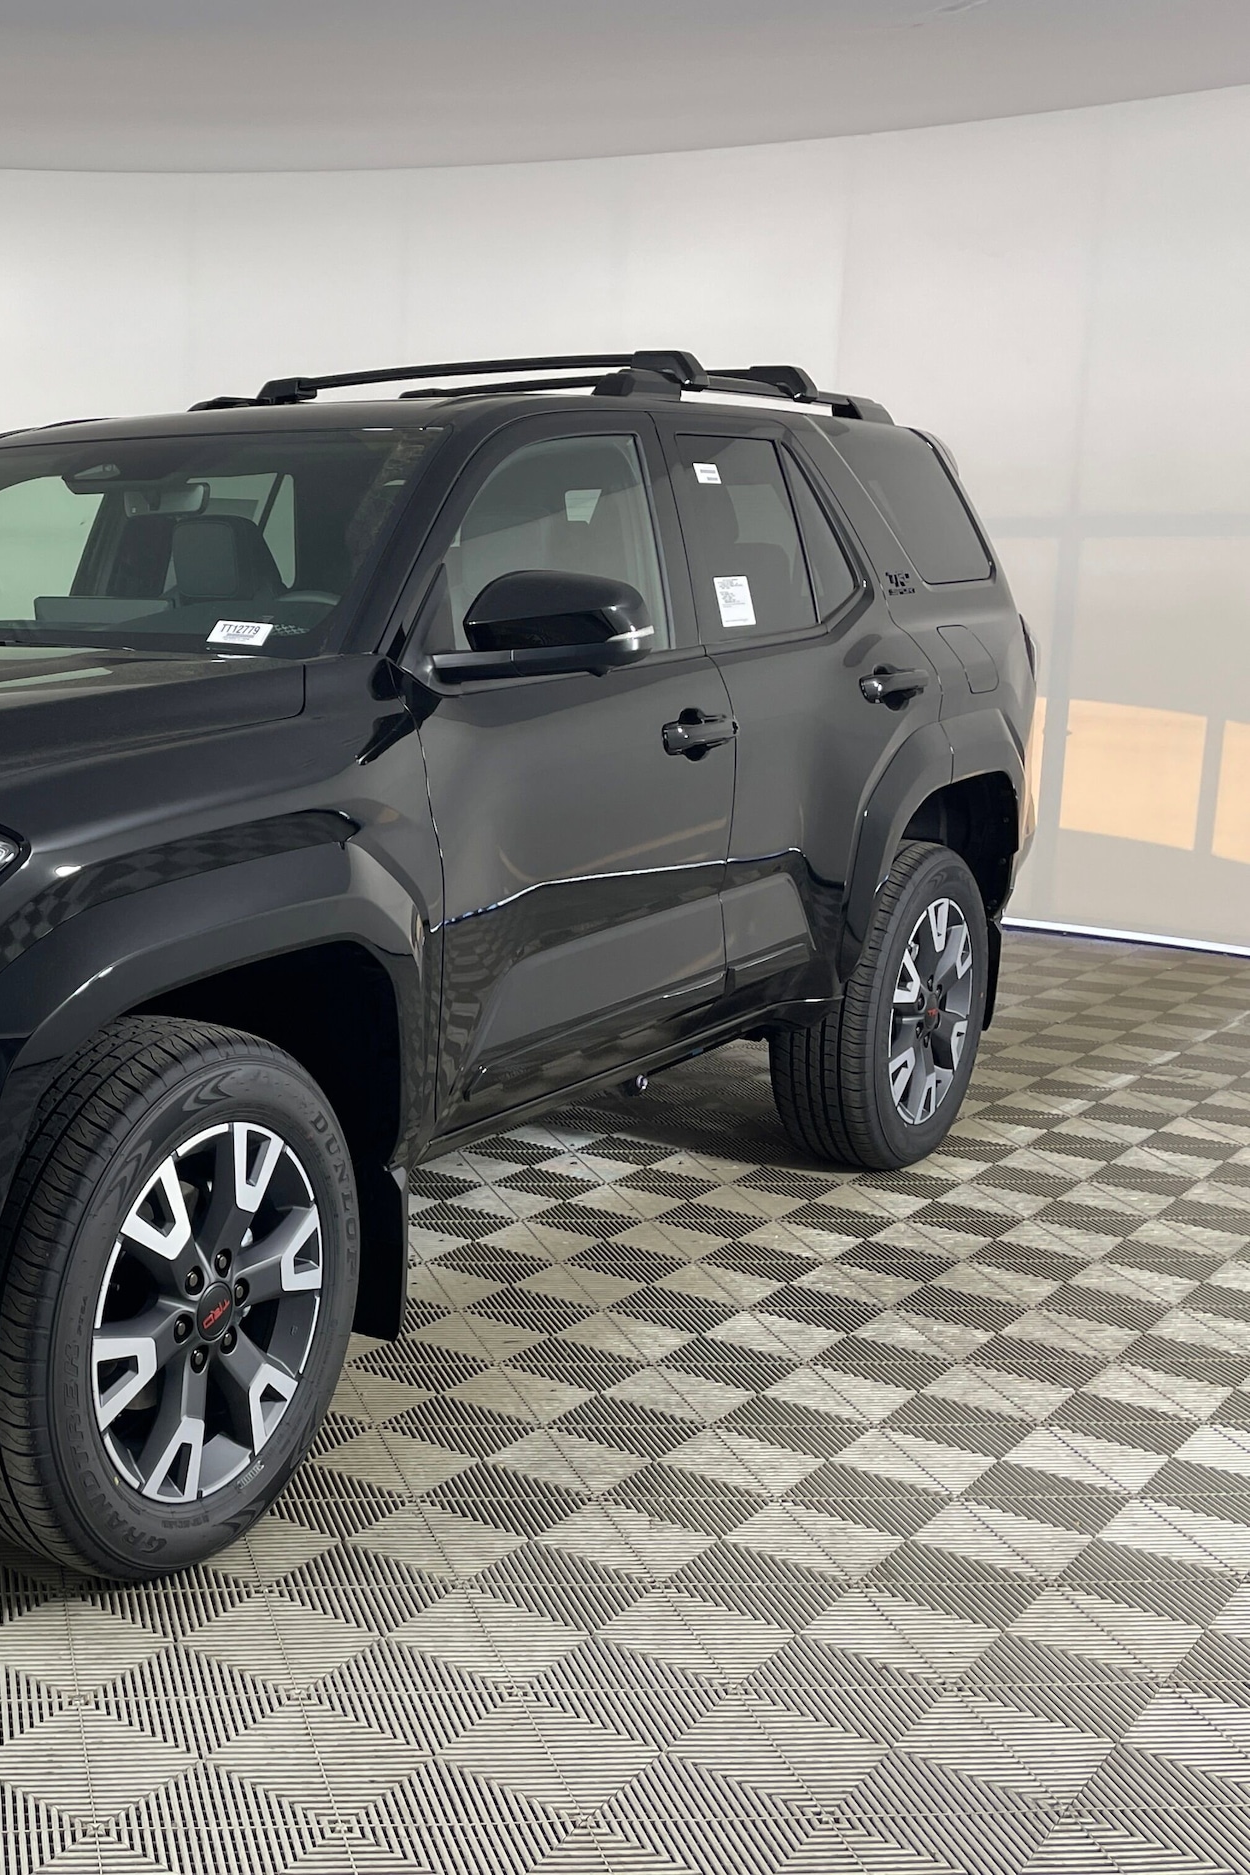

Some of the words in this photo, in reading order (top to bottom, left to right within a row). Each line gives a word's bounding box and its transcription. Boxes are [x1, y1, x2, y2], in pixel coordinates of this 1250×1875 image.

[220, 624, 261, 635] TT12779
[311, 1111, 358, 1283] DUNLOP
[64, 1340, 168, 1555] GRANDTREK
